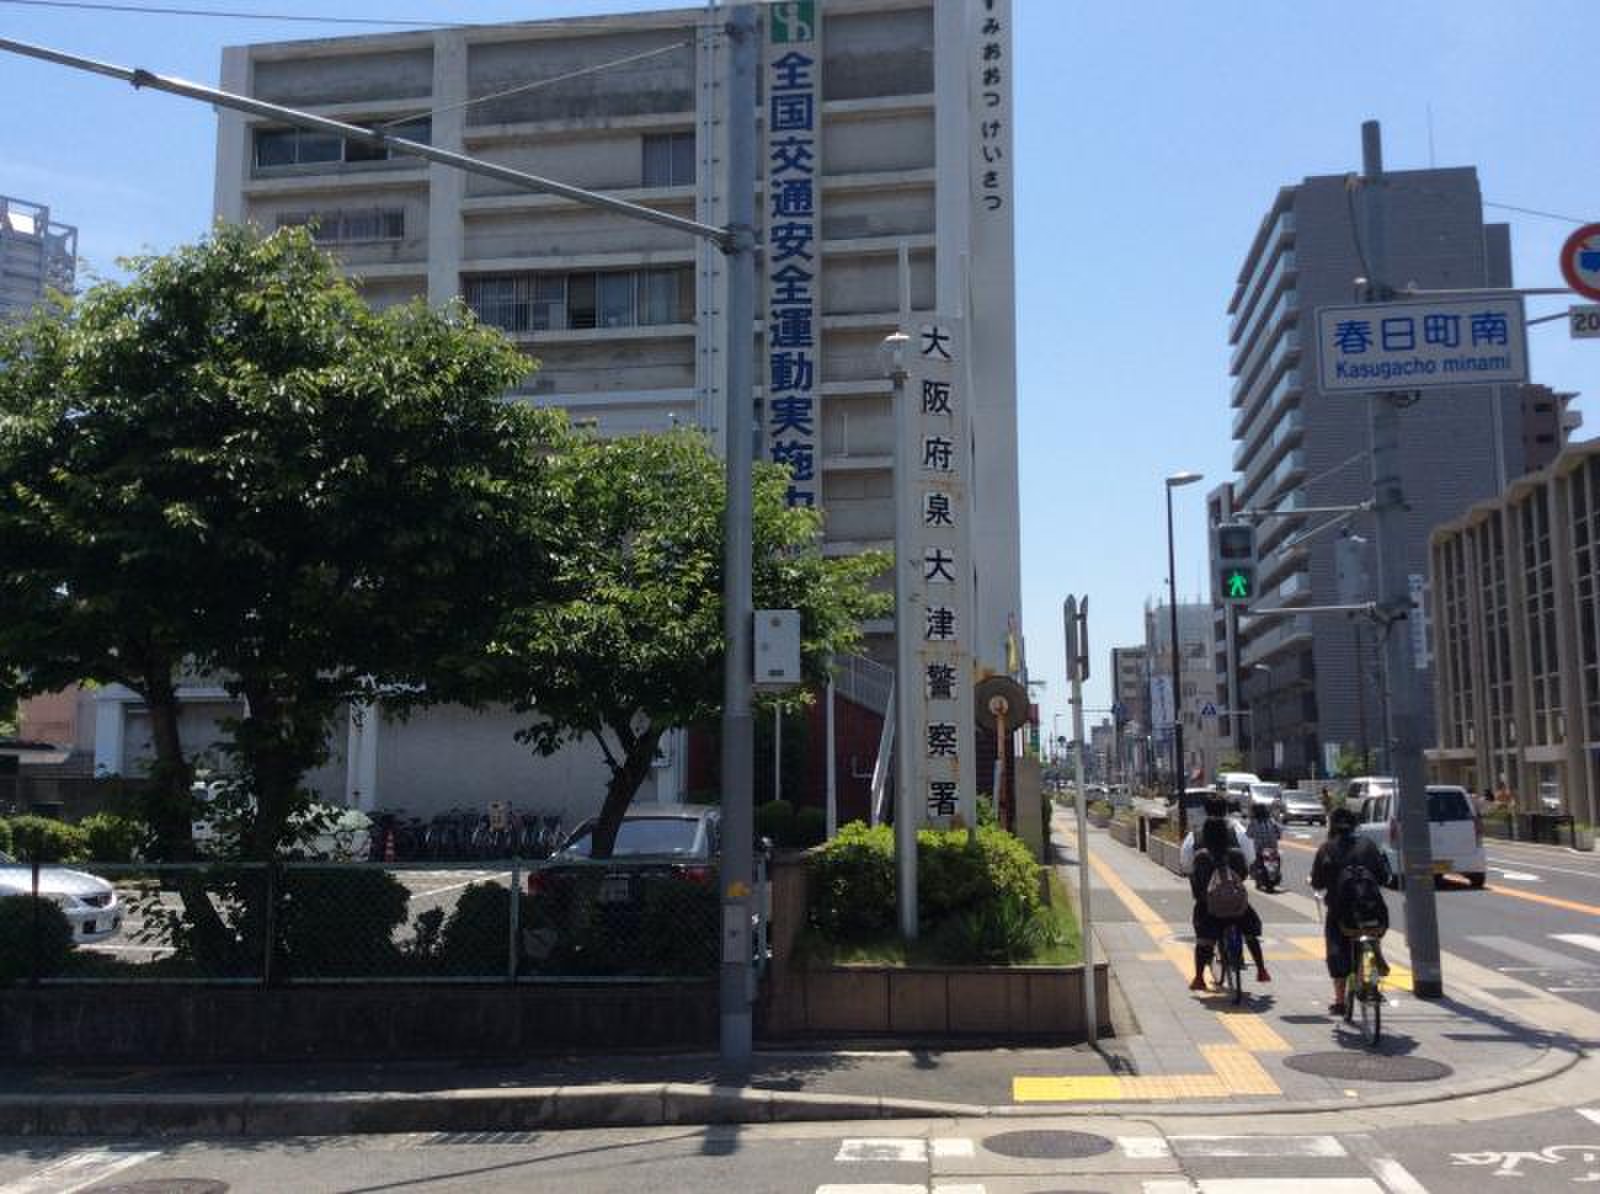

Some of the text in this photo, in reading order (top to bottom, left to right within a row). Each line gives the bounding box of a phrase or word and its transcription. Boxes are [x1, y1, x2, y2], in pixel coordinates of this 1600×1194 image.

[1334, 310, 1508, 354] 春日町南
[1335, 353, 1512, 379] Kasugacho minami
[920, 326, 959, 818] 大阪府泉大津警察署
